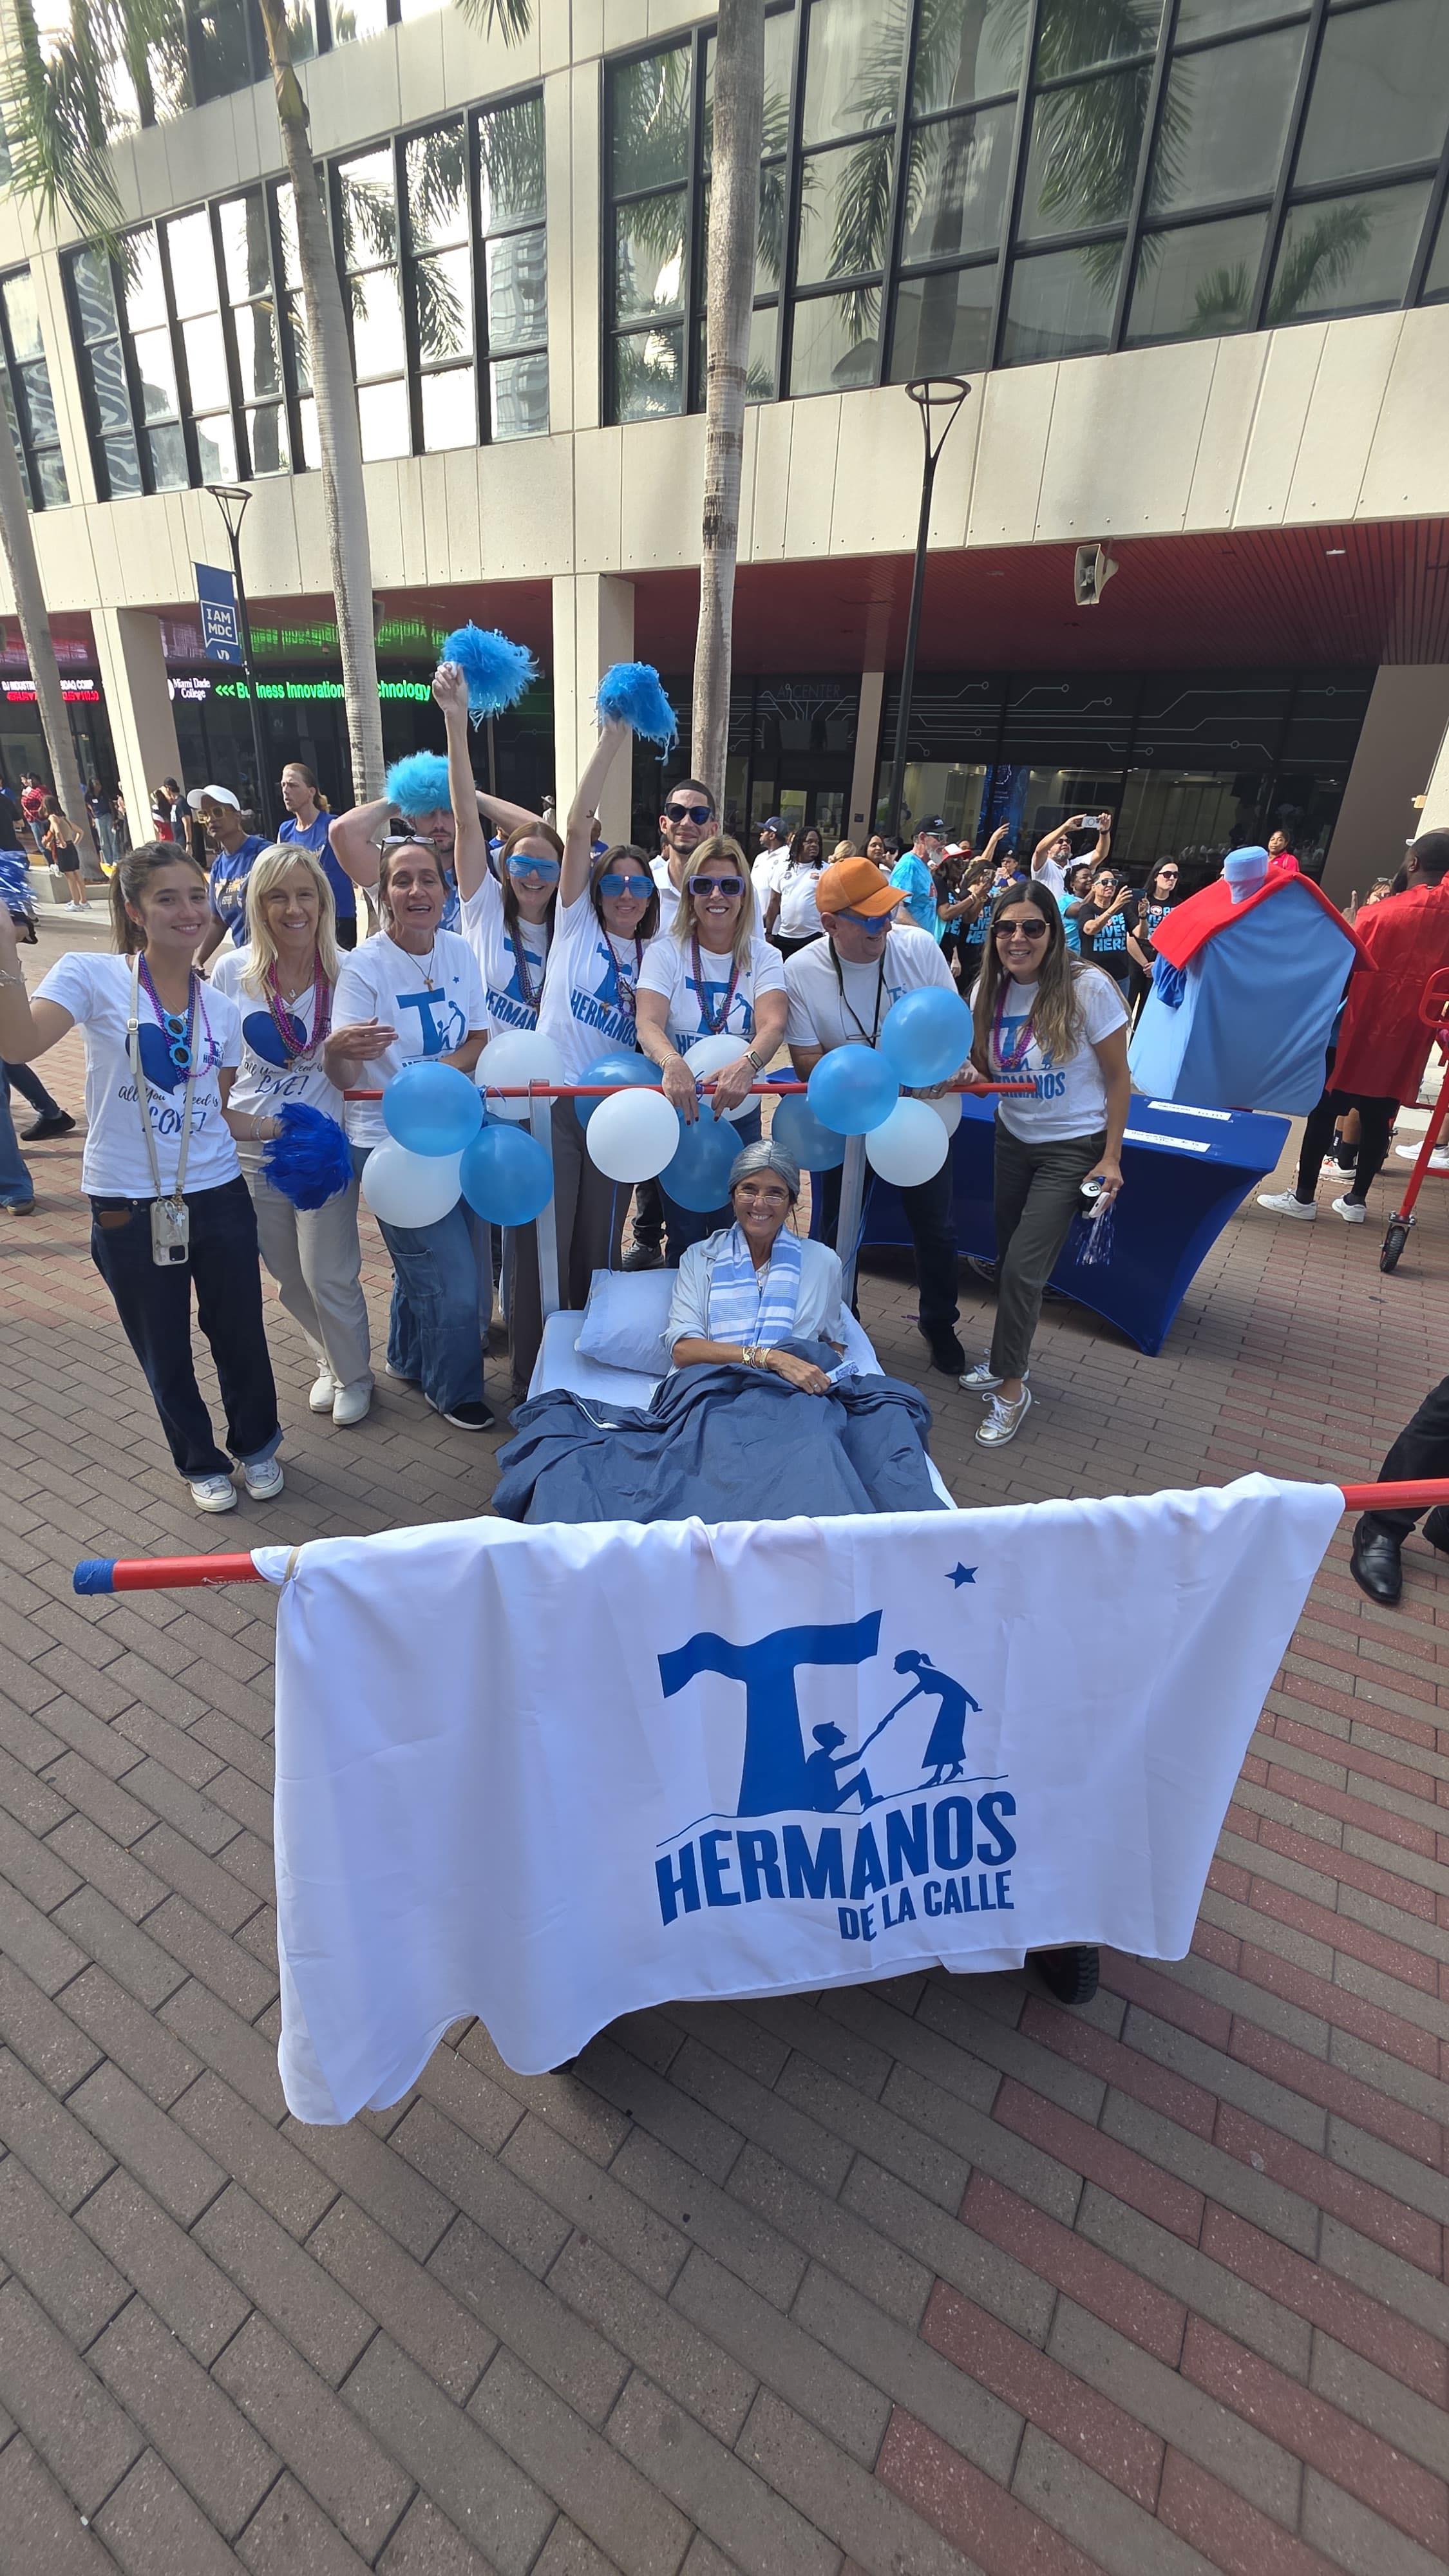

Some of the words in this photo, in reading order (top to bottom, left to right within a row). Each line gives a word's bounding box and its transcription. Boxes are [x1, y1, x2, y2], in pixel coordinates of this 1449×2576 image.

[213, 610, 231, 623] AM
[207, 622, 232, 637] MDC
[173, 678, 193, 688] Miami
[193, 678, 211, 688] Dade
[236, 681, 285, 699] Buiness
[286, 681, 345, 698] Innovation
[181, 688, 206, 700] College
[793, 684, 840, 699] CENTER
[571, 989, 637, 1047] HERMANOS
[655, 1791, 1016, 1926] HERMANOS
[838, 1903, 877, 1942] DE
[882, 1887, 917, 1929] LA
[923, 1870, 1014, 1917] CALLE
